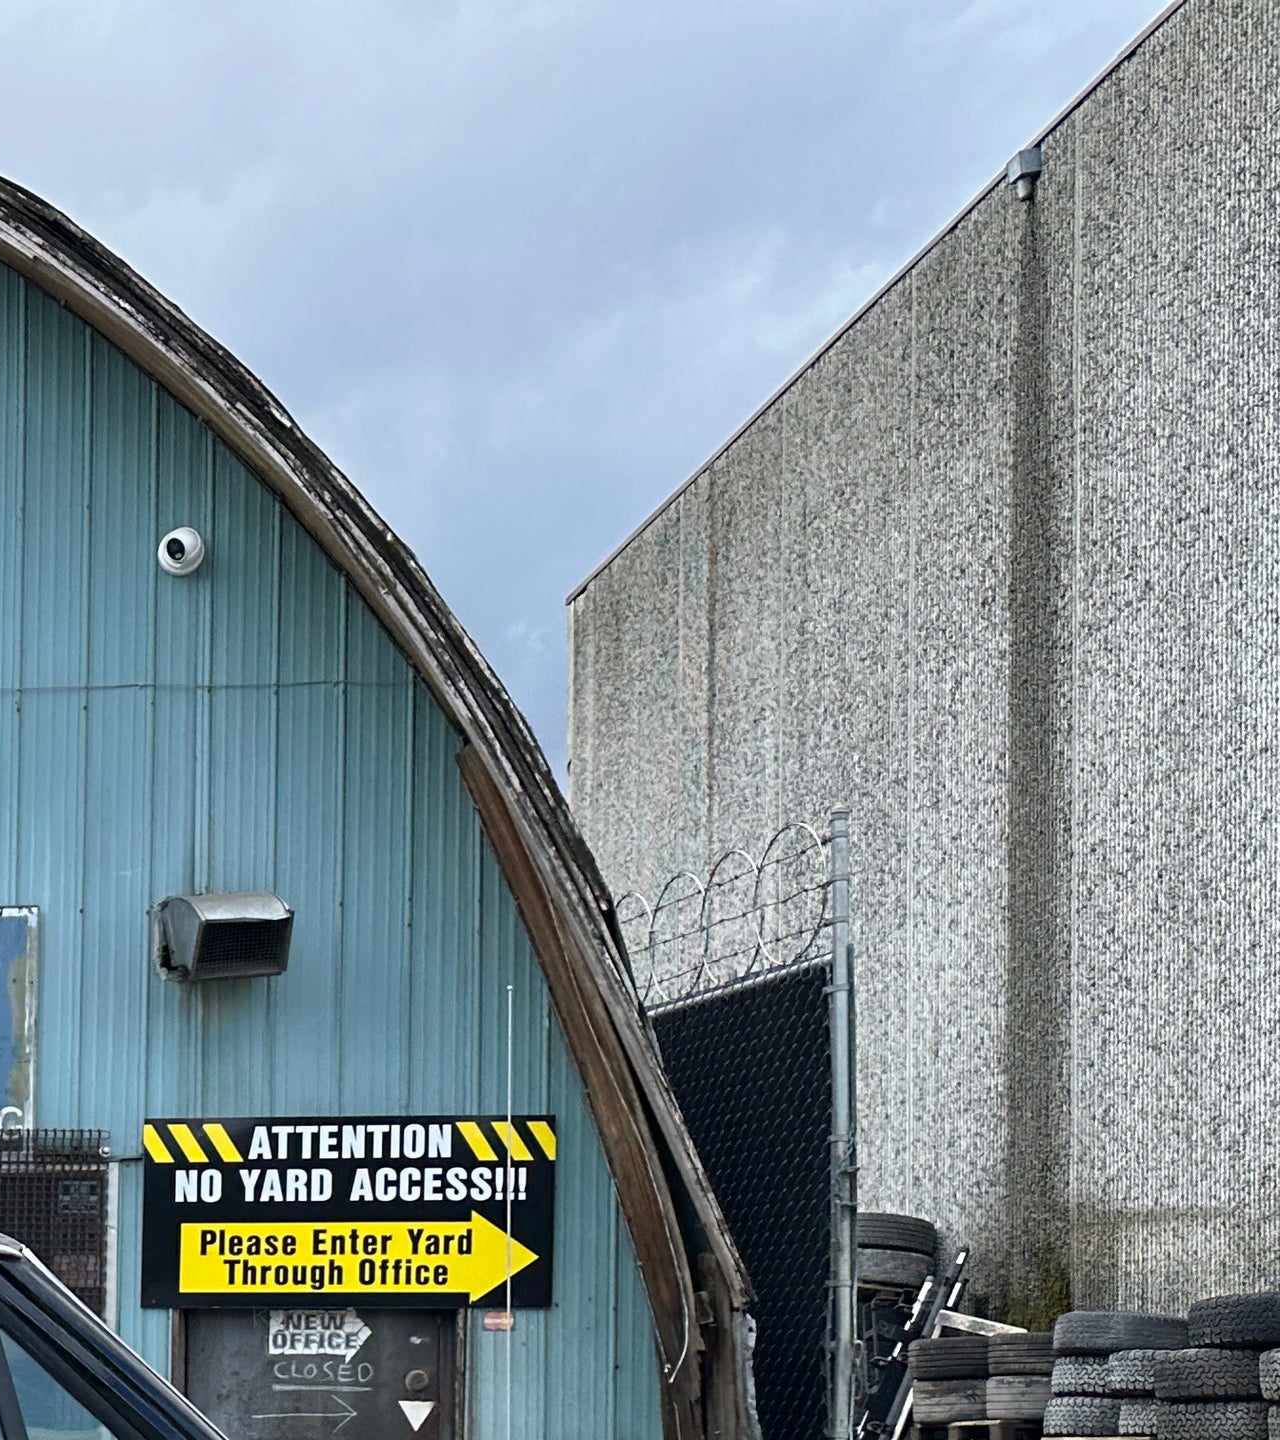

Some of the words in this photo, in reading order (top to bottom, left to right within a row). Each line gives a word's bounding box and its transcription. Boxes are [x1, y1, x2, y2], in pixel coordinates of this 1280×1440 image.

[248, 1123, 452, 1160] ATTENTION
[174, 1168, 222, 1203] NO
[239, 1167, 333, 1203] YARD
[349, 1166, 528, 1202] ACCESS!!!
[199, 1229, 297, 1257] Please
[312, 1229, 393, 1256] Enter
[407, 1228, 473, 1256] Yard
[223, 1259, 344, 1290] Through
[358, 1258, 449, 1286] Office
[283, 1312, 344, 1330] NEW
[272, 1331, 359, 1350] OFFICE
[273, 1360, 374, 1382] CLOSED
